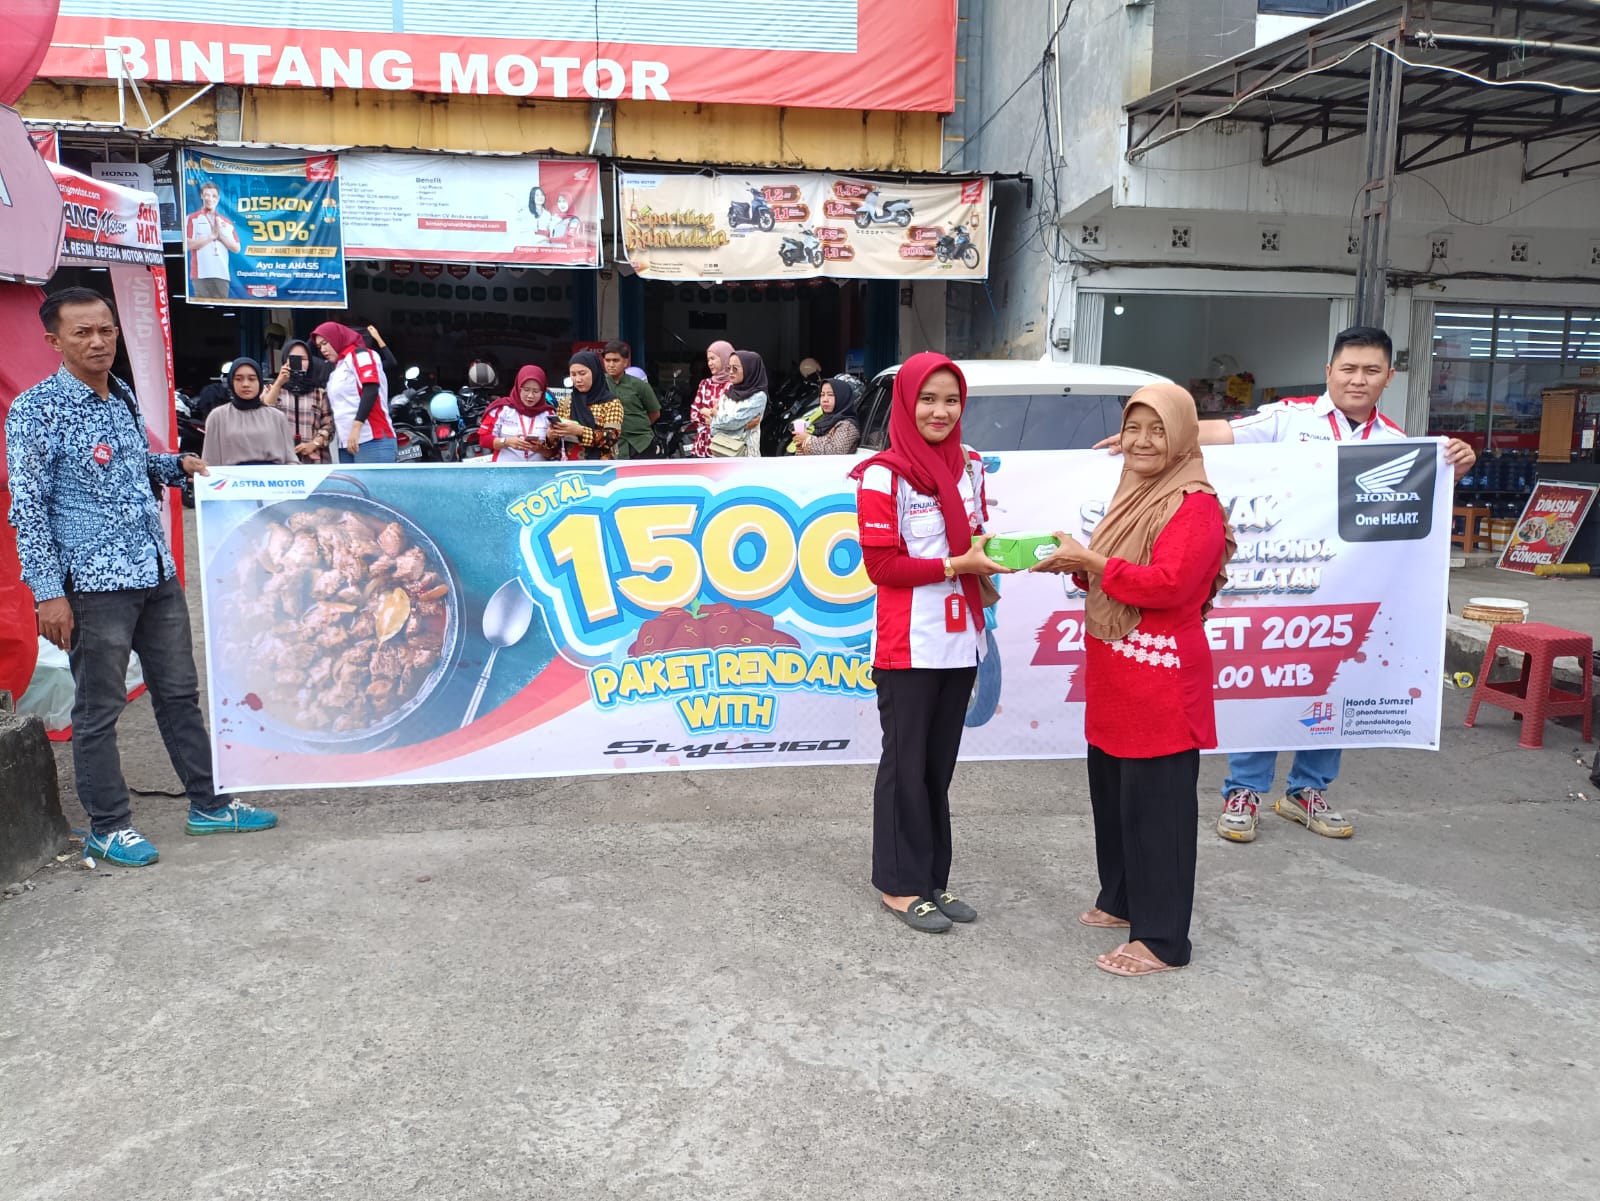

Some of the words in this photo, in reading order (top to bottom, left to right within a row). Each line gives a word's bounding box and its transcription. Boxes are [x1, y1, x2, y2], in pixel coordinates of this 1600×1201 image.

[104, 36, 413, 91] BINTANG
[439, 52, 672, 101] MOTOR
[64, 202, 98, 231] ANG
[237, 196, 314, 213] DISKON
[71, 240, 95, 255] RESMI
[95, 245, 122, 260] SEPEDA
[121, 248, 144, 263] MOTOR
[144, 252, 164, 265] HONDA
[256, 261, 274, 270] Ayo
[275, 261, 287, 269] ke
[231, 479, 266, 488] ASTRA
[267, 479, 305, 488] MOTOR
[509, 475, 590, 526] TOTAL
[1355, 492, 1421, 503] HONDA
[1534, 498, 1580, 513] DIMSUM
[1355, 513, 1380, 526] One
[1381, 512, 1419, 525] HEART.
[547, 503, 877, 623] 1500
[1256, 539, 1337, 563] HONDA
[1219, 566, 1321, 595] SELATAN
[1261, 613, 1354, 650] 2025
[593, 653, 711, 703] PAKET
[1260, 663, 1315, 688] WIB
[679, 694, 774, 730] WITH
[1345, 699, 1377, 707] Honda
[1378, 697, 1414, 706] Sumsel
